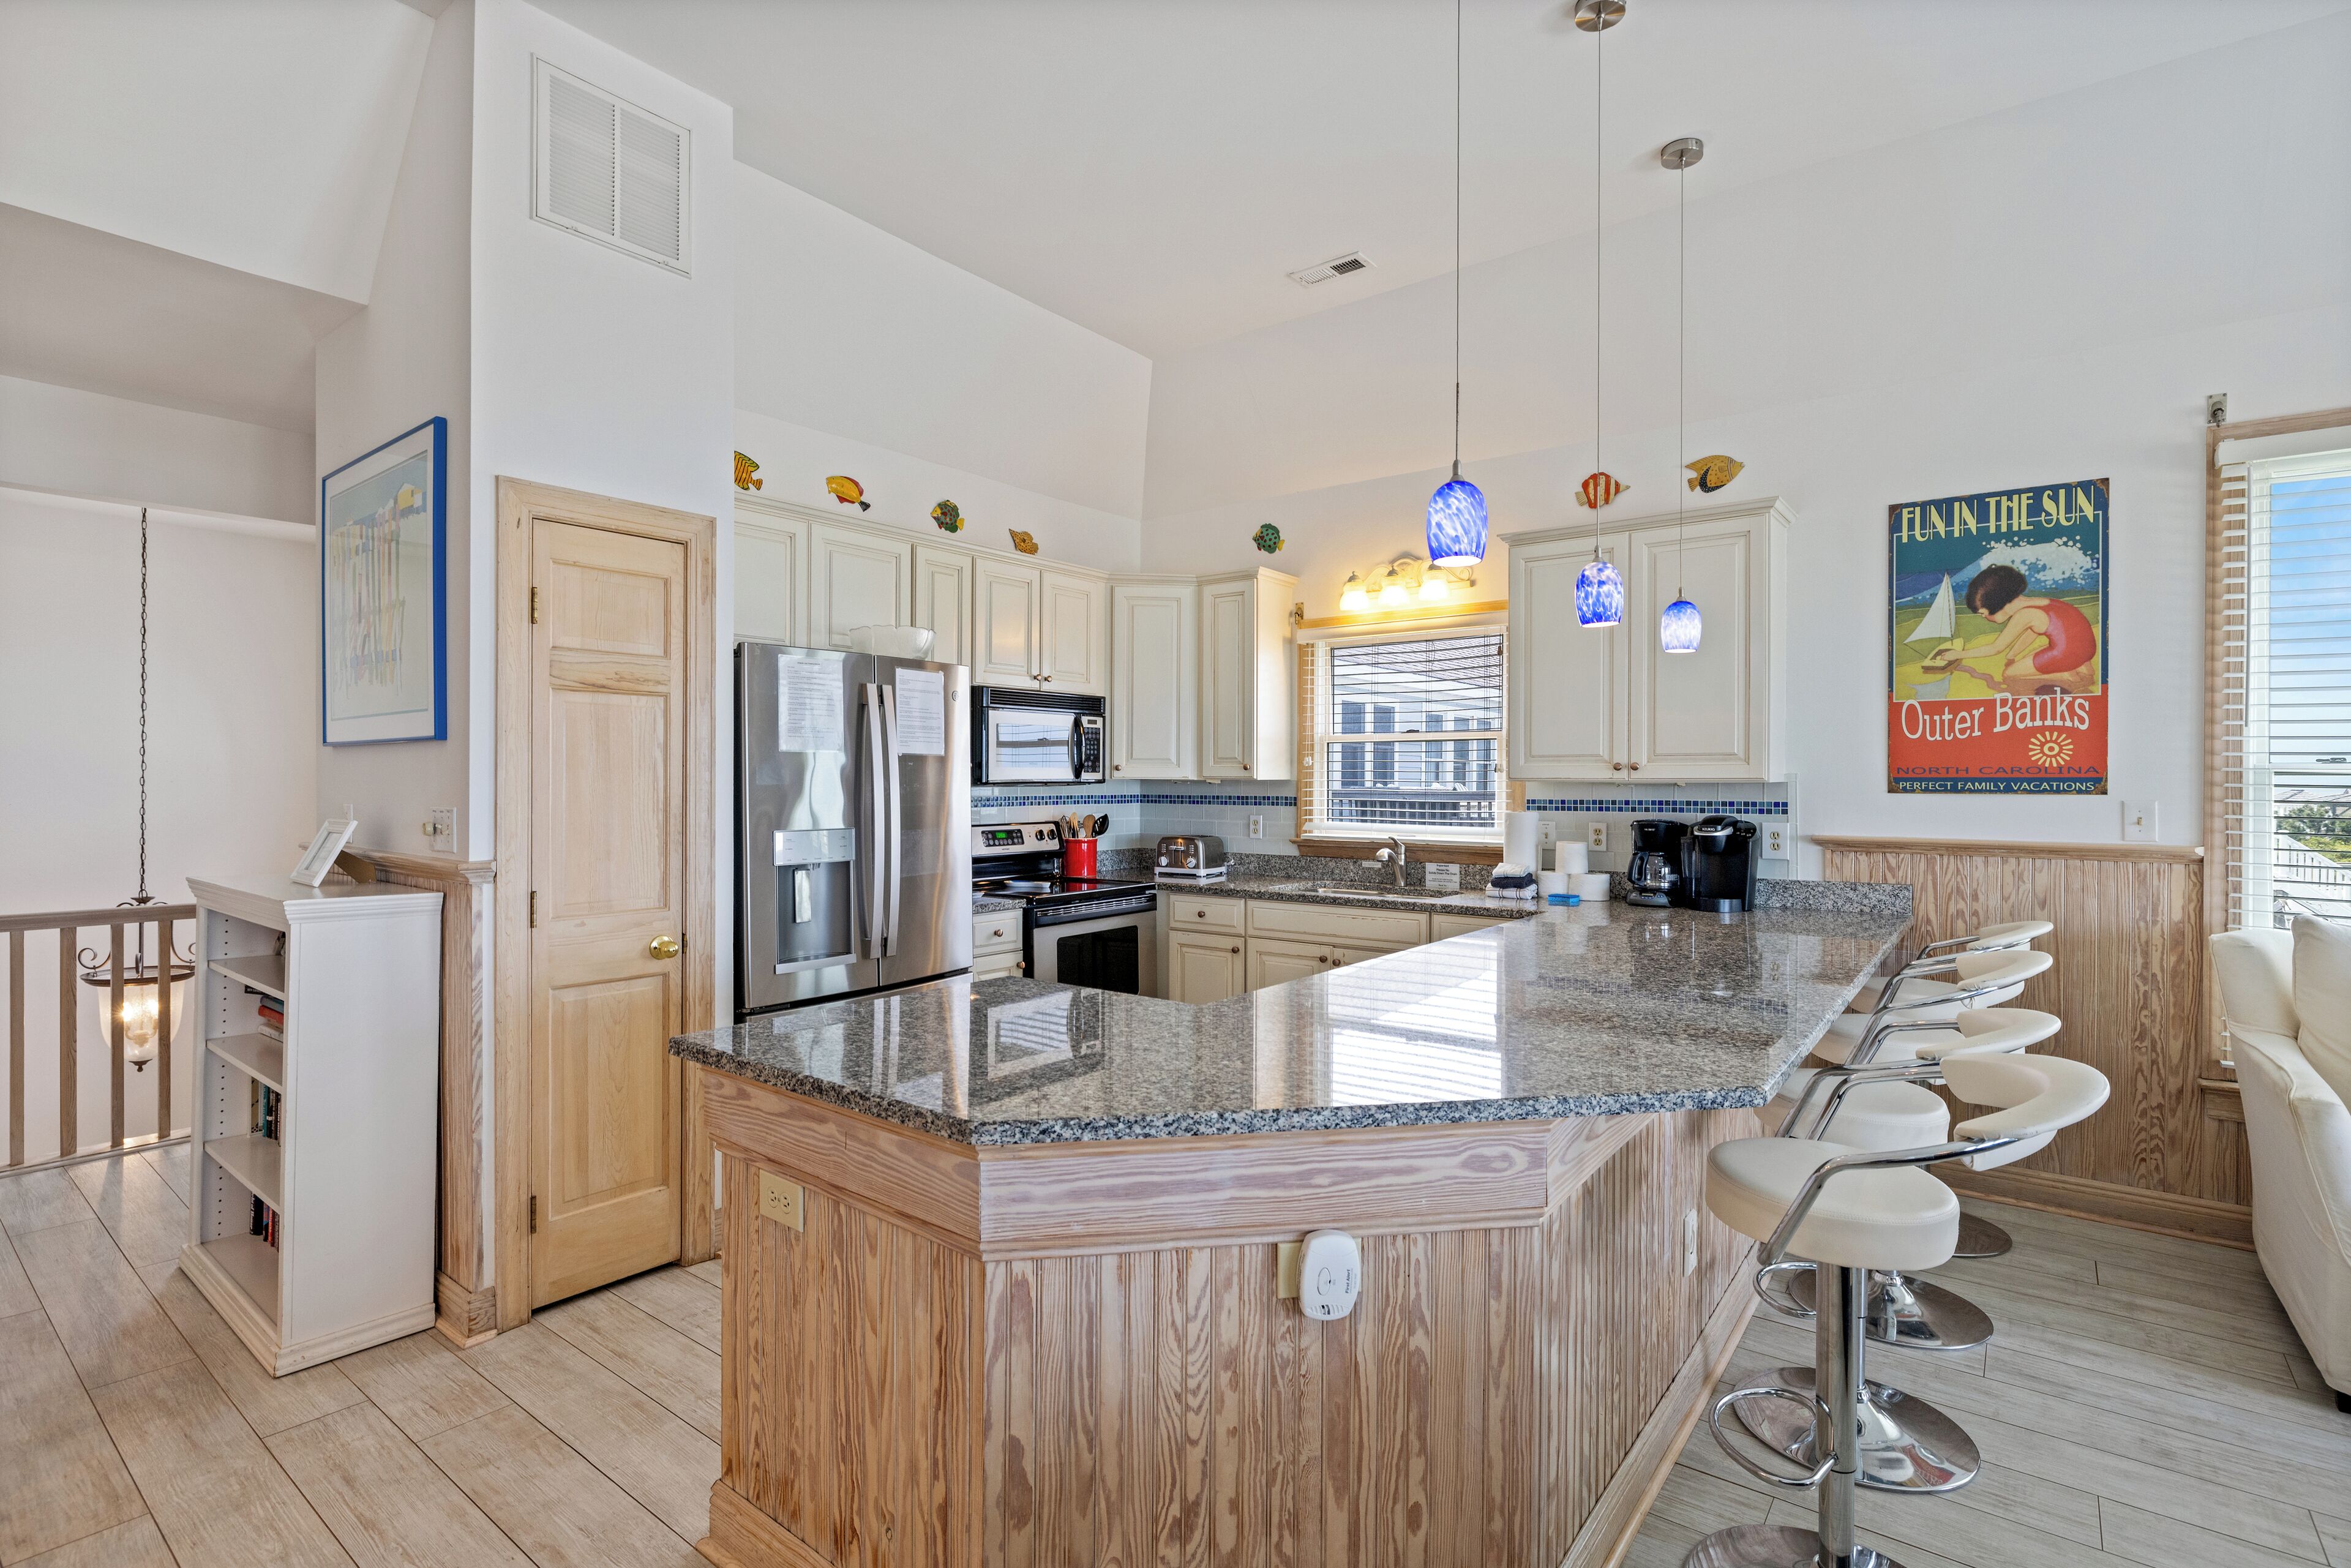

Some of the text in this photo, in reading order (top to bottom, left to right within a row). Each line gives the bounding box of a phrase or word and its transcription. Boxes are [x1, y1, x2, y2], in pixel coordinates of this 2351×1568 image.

[1902, 485, 2094, 543] FUN IN THE SUN
[1901, 686, 2090, 741] Outer Banks
[1897, 766, 2100, 775] NORTH CAROLINA
[1899, 781, 2094, 791] PERFECT FAMILY VACATIONS
